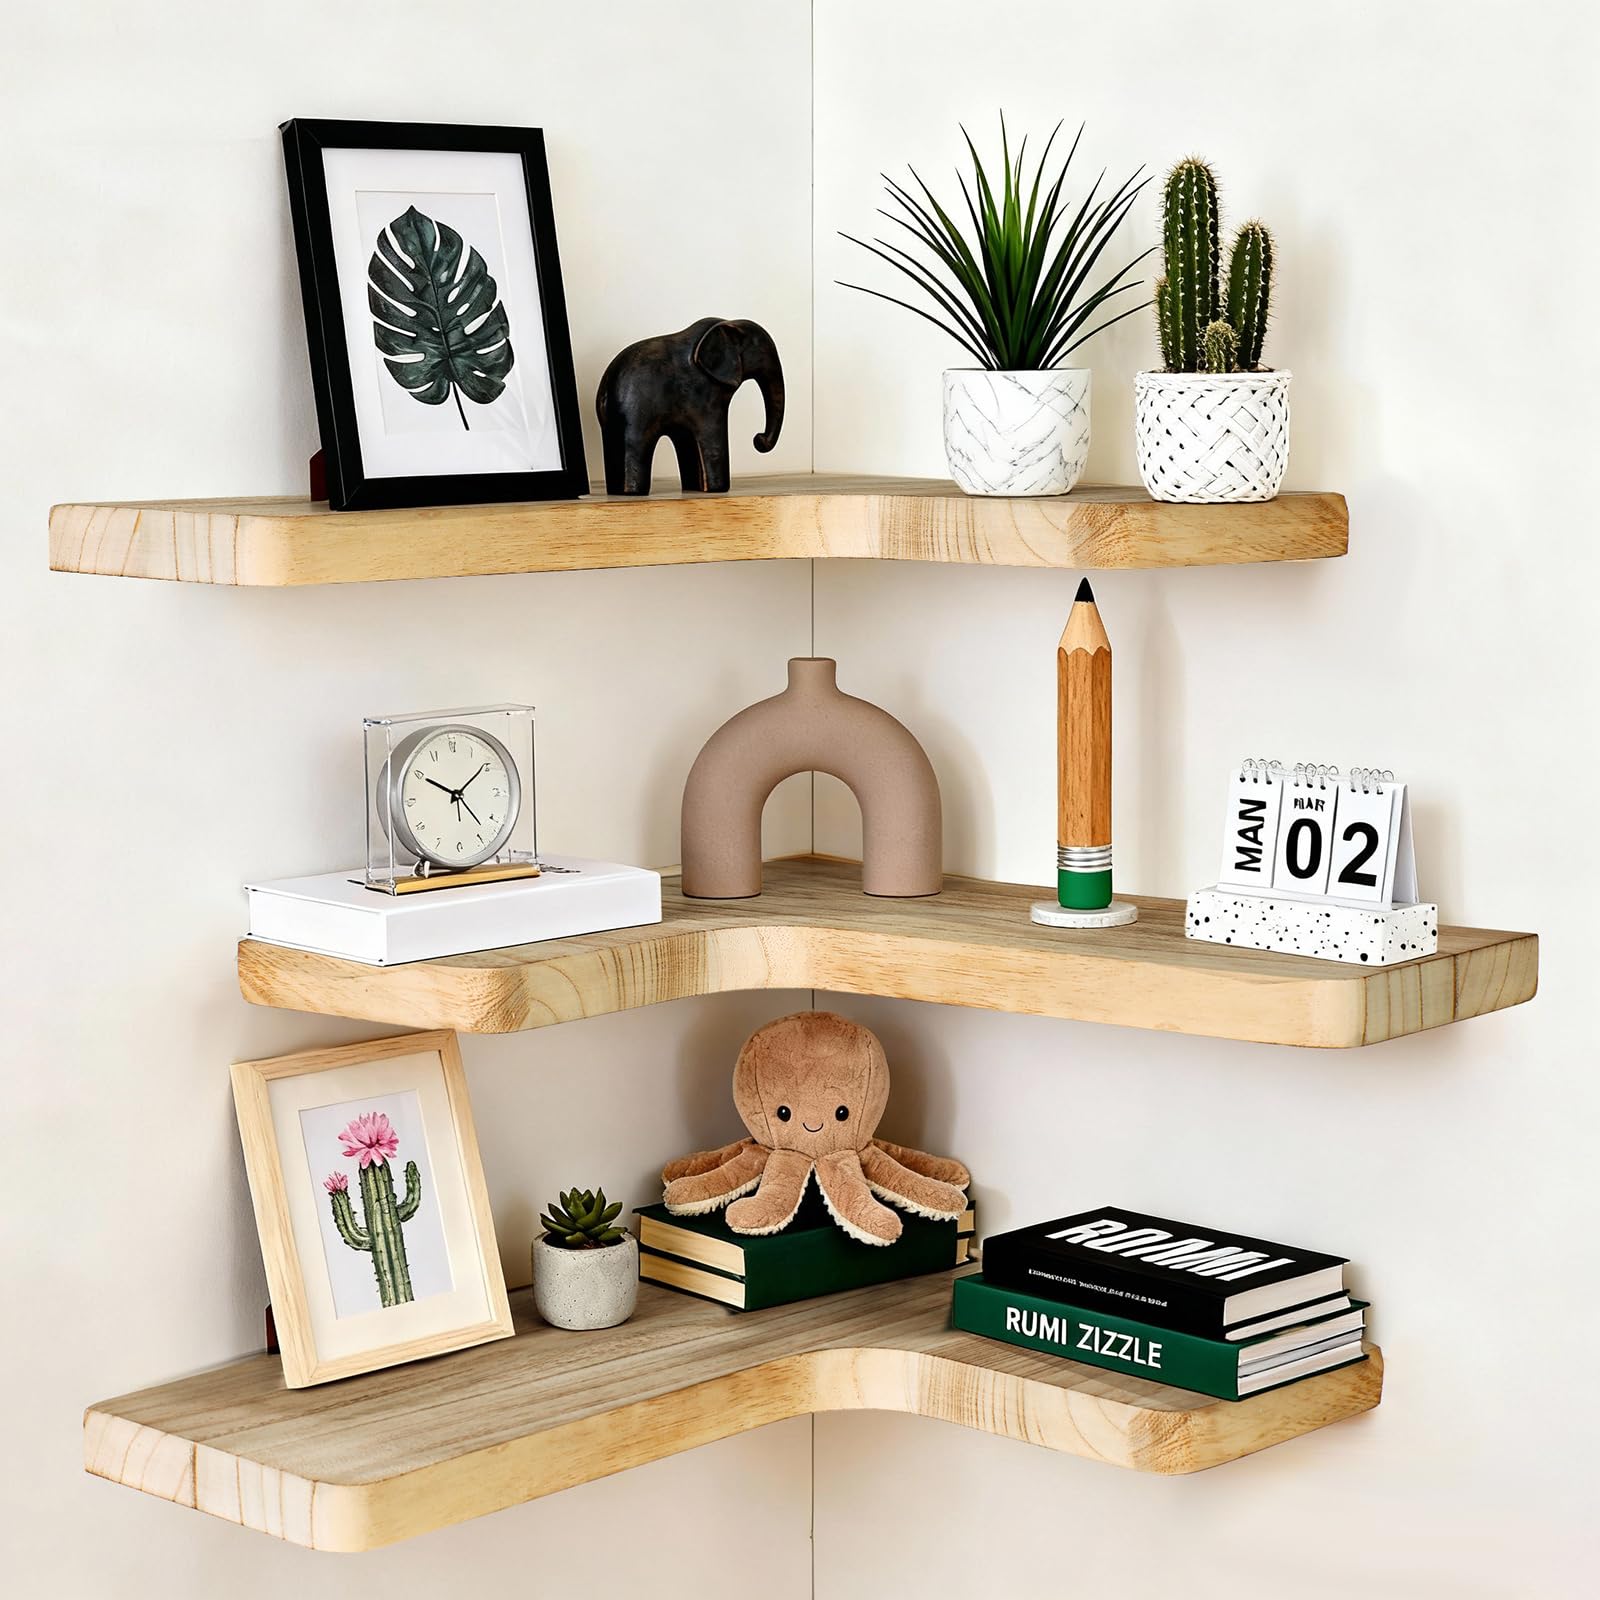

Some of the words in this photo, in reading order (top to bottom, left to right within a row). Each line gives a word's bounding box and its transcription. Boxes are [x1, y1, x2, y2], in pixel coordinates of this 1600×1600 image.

[1234, 798, 1267, 873] MAN
[1006, 1306, 1067, 1346] RUMI
[1076, 1322, 1163, 1369] ZIZZLE
